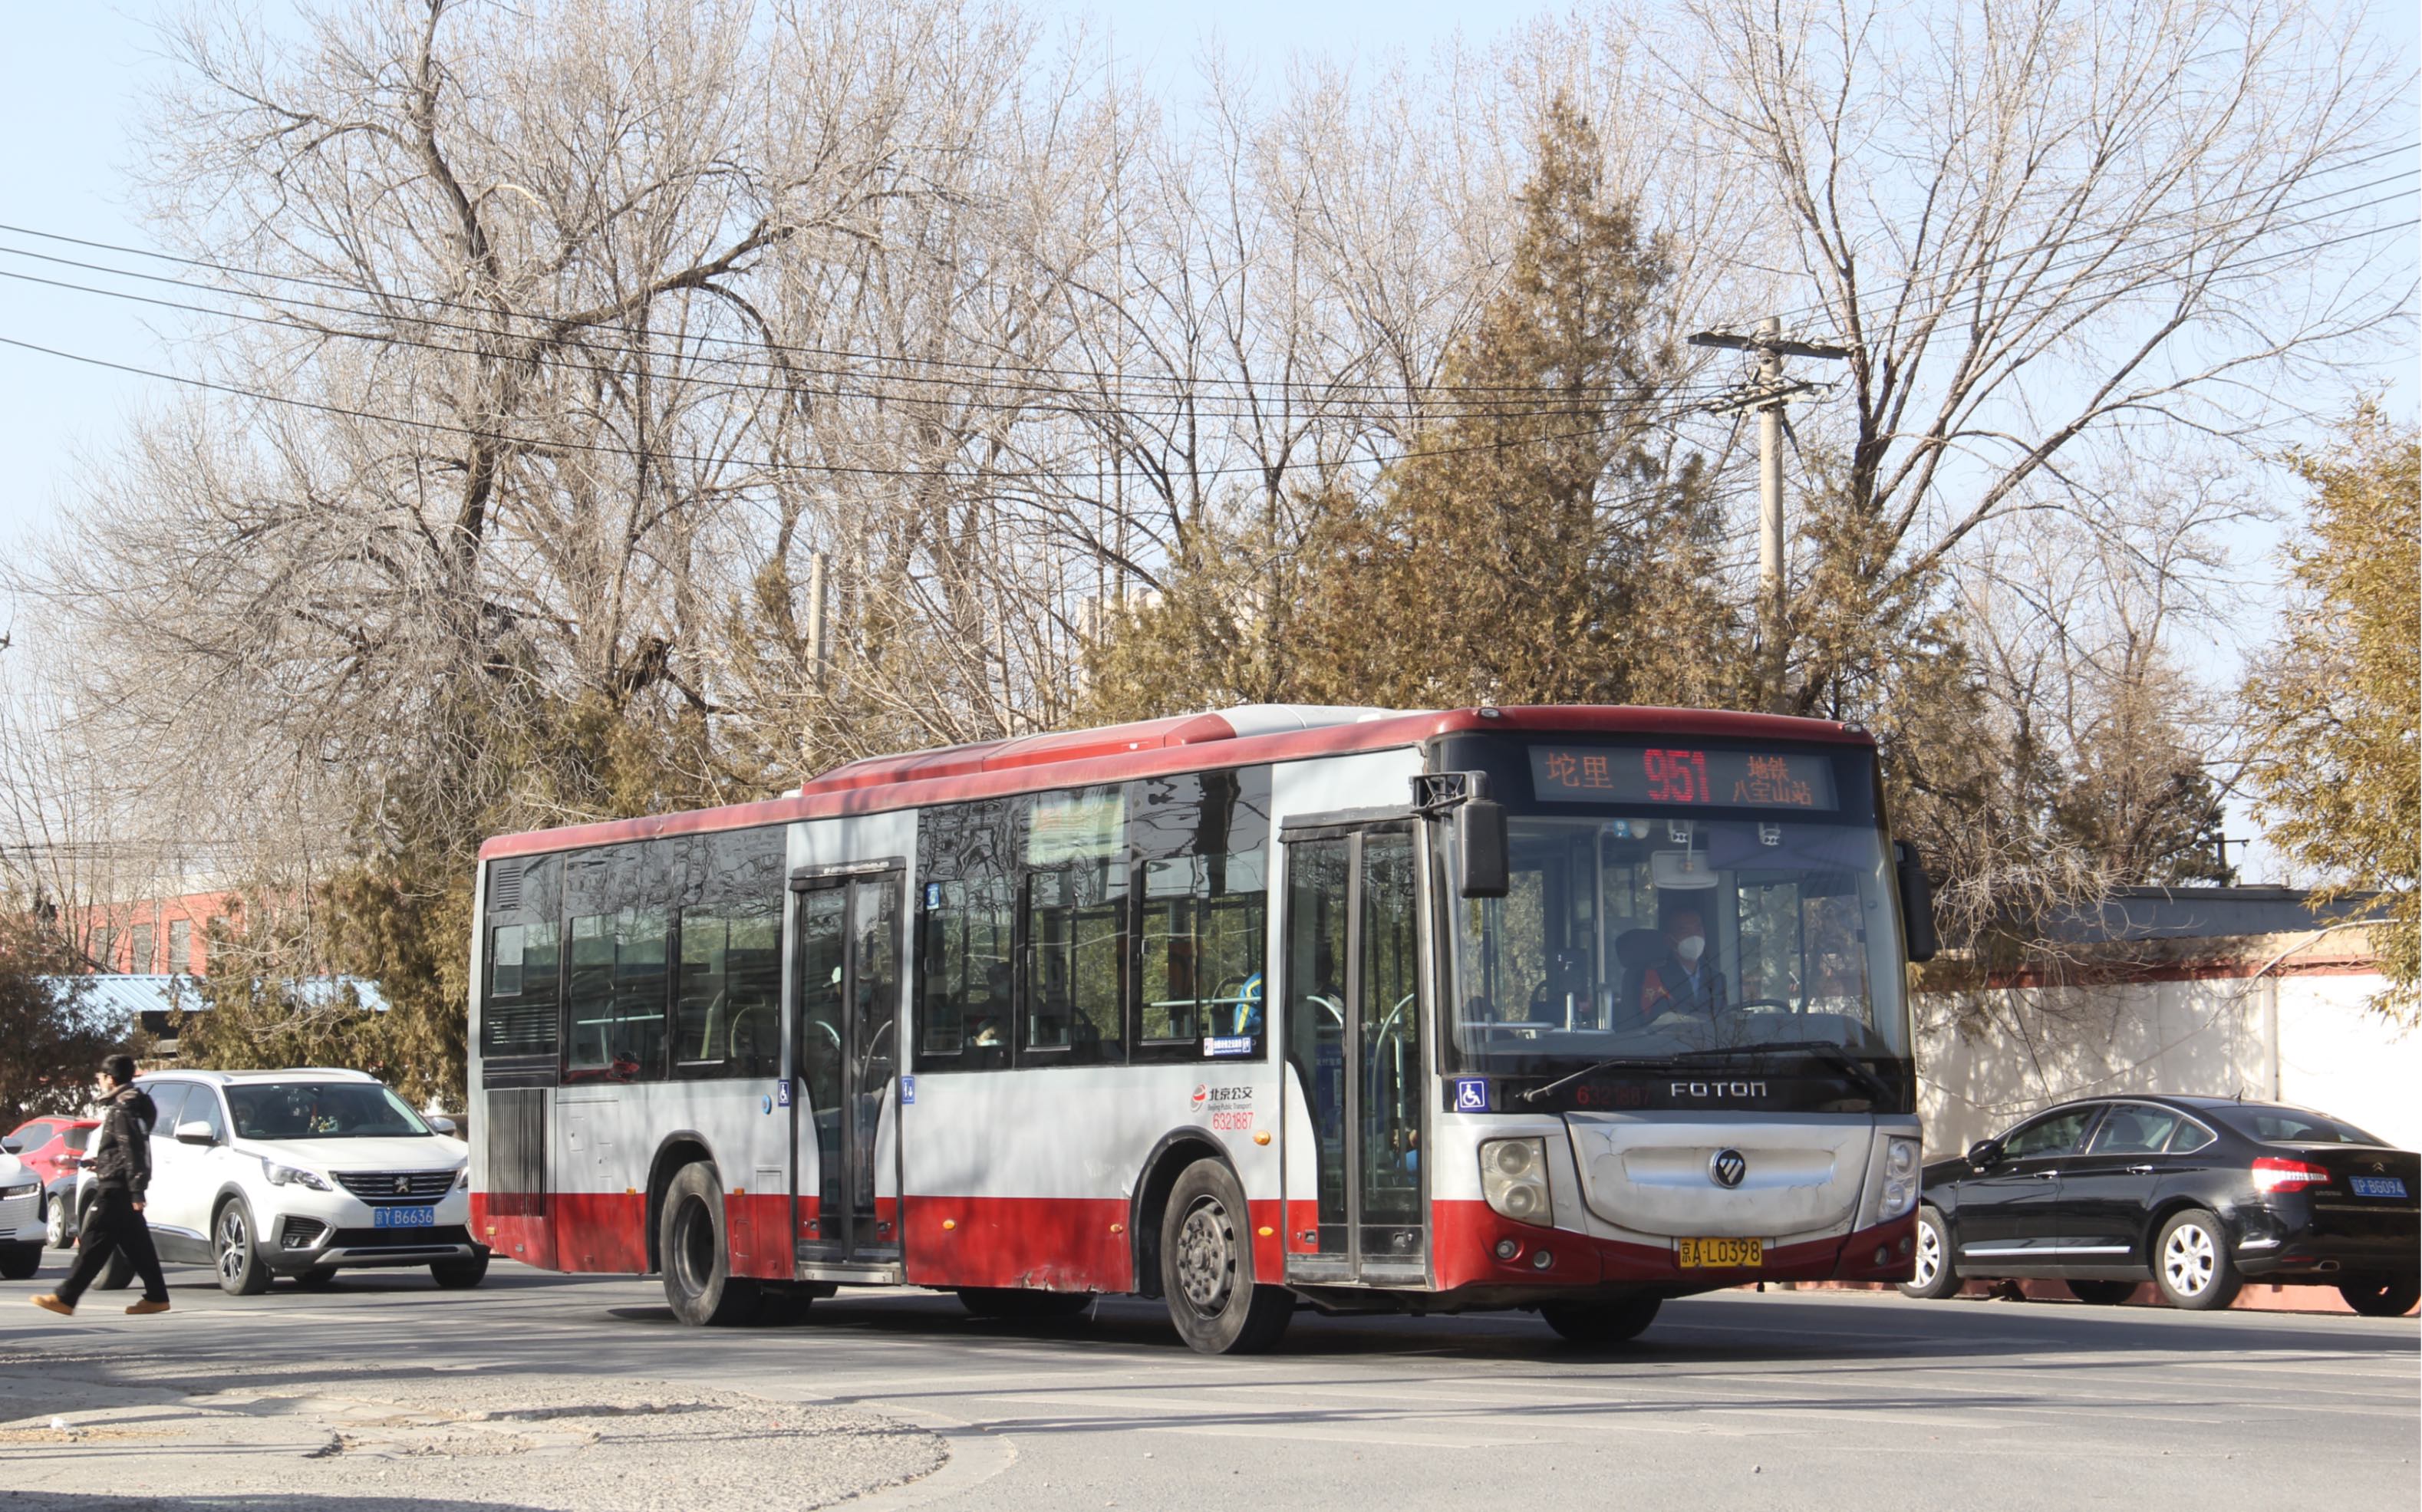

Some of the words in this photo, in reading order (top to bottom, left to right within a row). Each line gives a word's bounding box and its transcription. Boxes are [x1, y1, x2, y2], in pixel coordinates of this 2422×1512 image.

[1546, 751, 1614, 789] 坨里
[1643, 748, 1711, 802] 951
[1748, 755, 1788, 781] 地铁
[1732, 779, 1812, 805] 八宝山站
[1209, 1086, 1253, 1101] 北京公交
[1671, 1081, 1767, 1097] FOTON
[1213, 1112, 1254, 1130] 6321887
